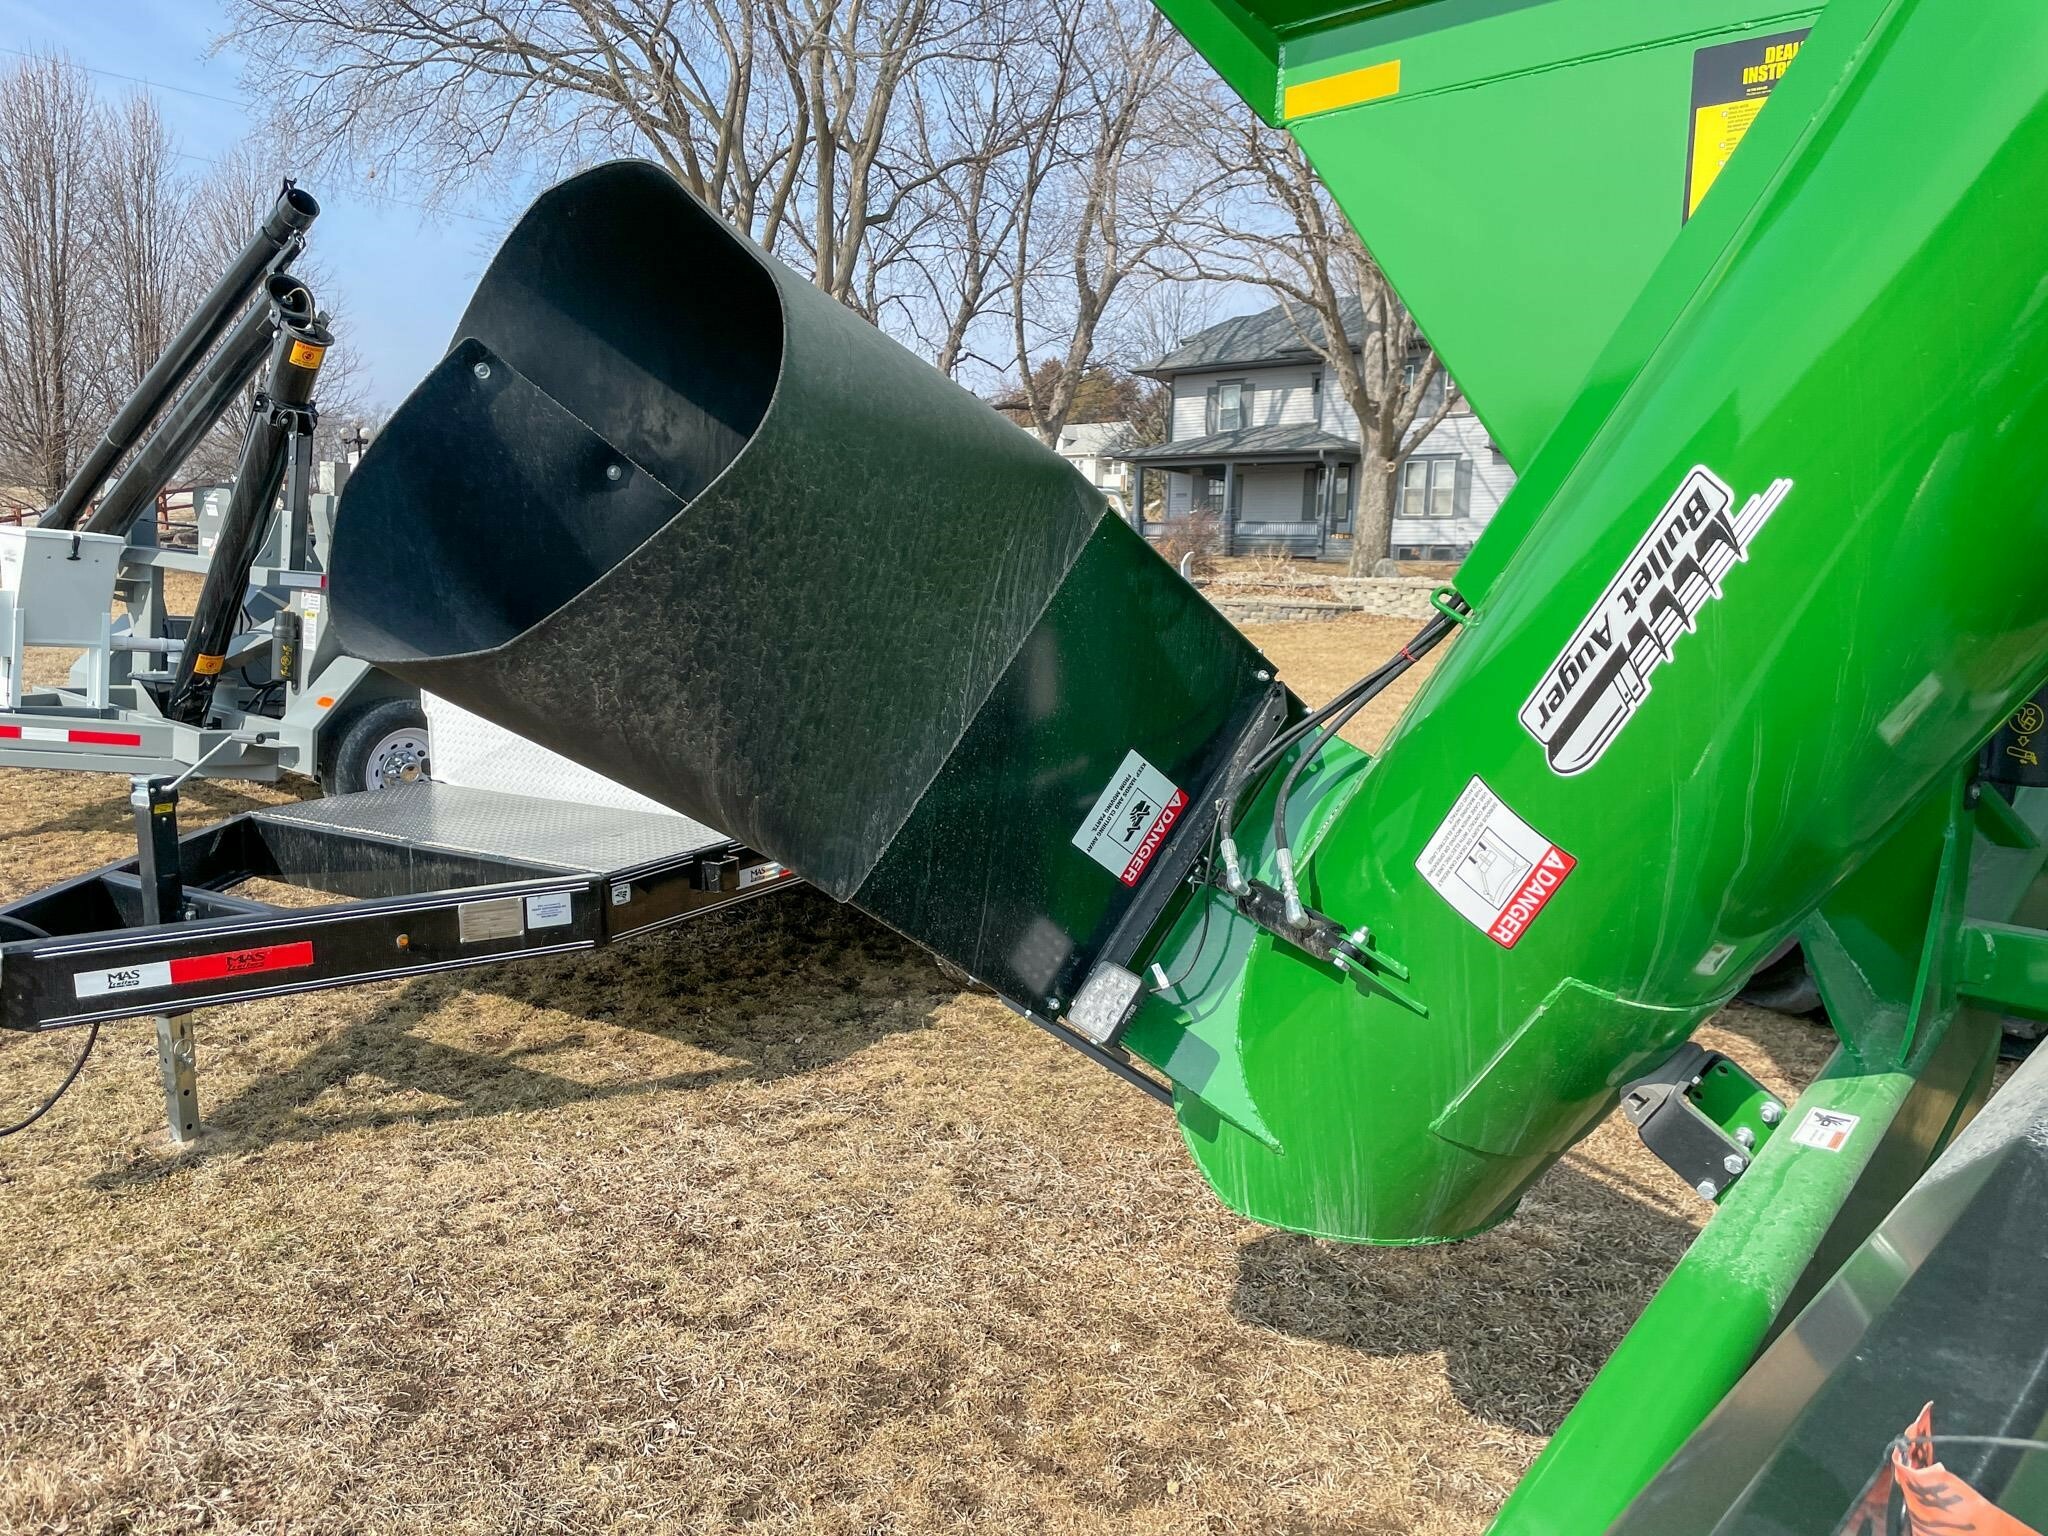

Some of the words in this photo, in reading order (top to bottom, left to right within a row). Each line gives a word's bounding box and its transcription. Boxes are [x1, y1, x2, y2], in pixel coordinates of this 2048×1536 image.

[1764, 41, 1804, 64] DEAL
[1743, 60, 1792, 85] INSTR
[1615, 487, 1711, 615] Bullet
[1535, 613, 1614, 730] Auger
[1134, 762, 1146, 777] KEEP
[1118, 773, 1131, 790] FROM
[1122, 777, 1136, 796] HANDS
[1104, 790, 1120, 813] MOVING
[1114, 796, 1124, 809] AND
[1479, 791, 1487, 802] USE
[1481, 796, 1492, 811] FROM
[1470, 801, 1481, 815] CARE
[1096, 809, 1115, 837] CLOTHING
[1451, 817, 1461, 830] NEAR
[1460, 814, 1471, 828] WHEN
[1466, 810, 1483, 832] CONTACT
[1085, 835, 1098, 853] AWAY
[1123, 808, 1174, 882] DANGER
[1436, 829, 1452, 851] ELECTRIC
[1448, 828, 1462, 846] MOVING
[1458, 831, 1468, 843] WITH
[1465, 837, 1472, 846] OR
[1443, 845, 1450, 853] OR
[1444, 842, 1460, 864] ELECTRIC
[1455, 844, 1467, 861] DEATH
[1448, 859, 1457, 870] CAN
[1436, 868, 1450, 886] RESULT
[1492, 867, 1556, 944] DANGER
[227, 952, 265, 965] MAS
[107, 970, 140, 982] MAS
